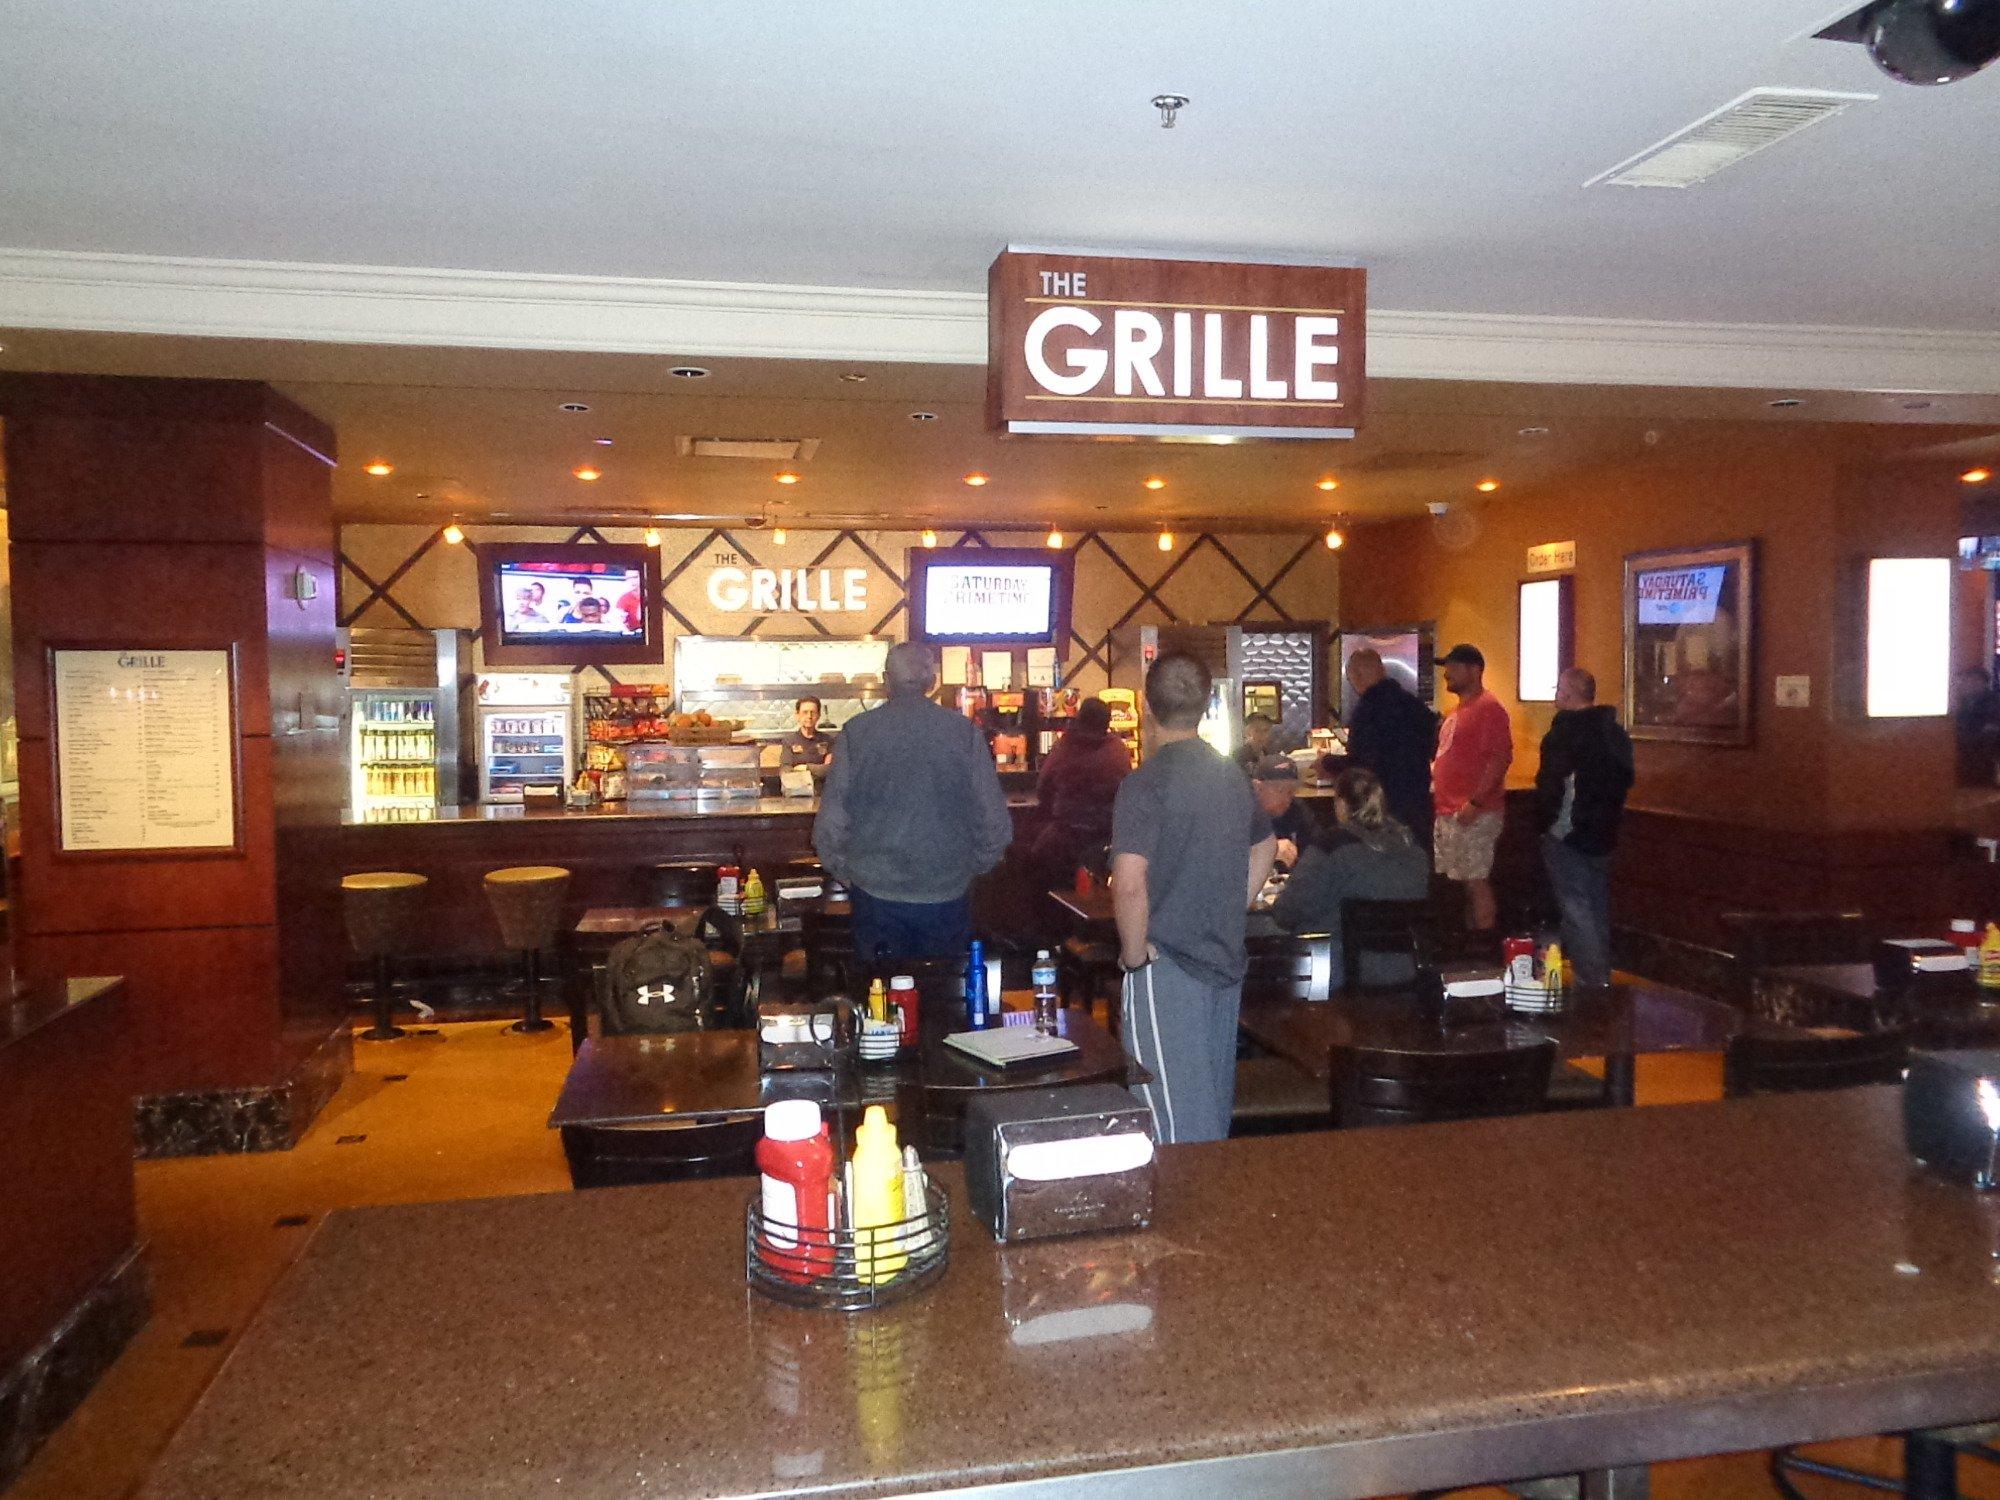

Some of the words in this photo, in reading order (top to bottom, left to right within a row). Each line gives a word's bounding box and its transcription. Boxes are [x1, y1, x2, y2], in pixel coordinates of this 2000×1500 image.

[1039, 271, 1086, 297] THE
[1024, 306, 1339, 400] GRILLE
[714, 553, 738, 565] THE
[706, 567, 868, 612] GRILLE
[950, 574, 1031, 591] SATURDAY
